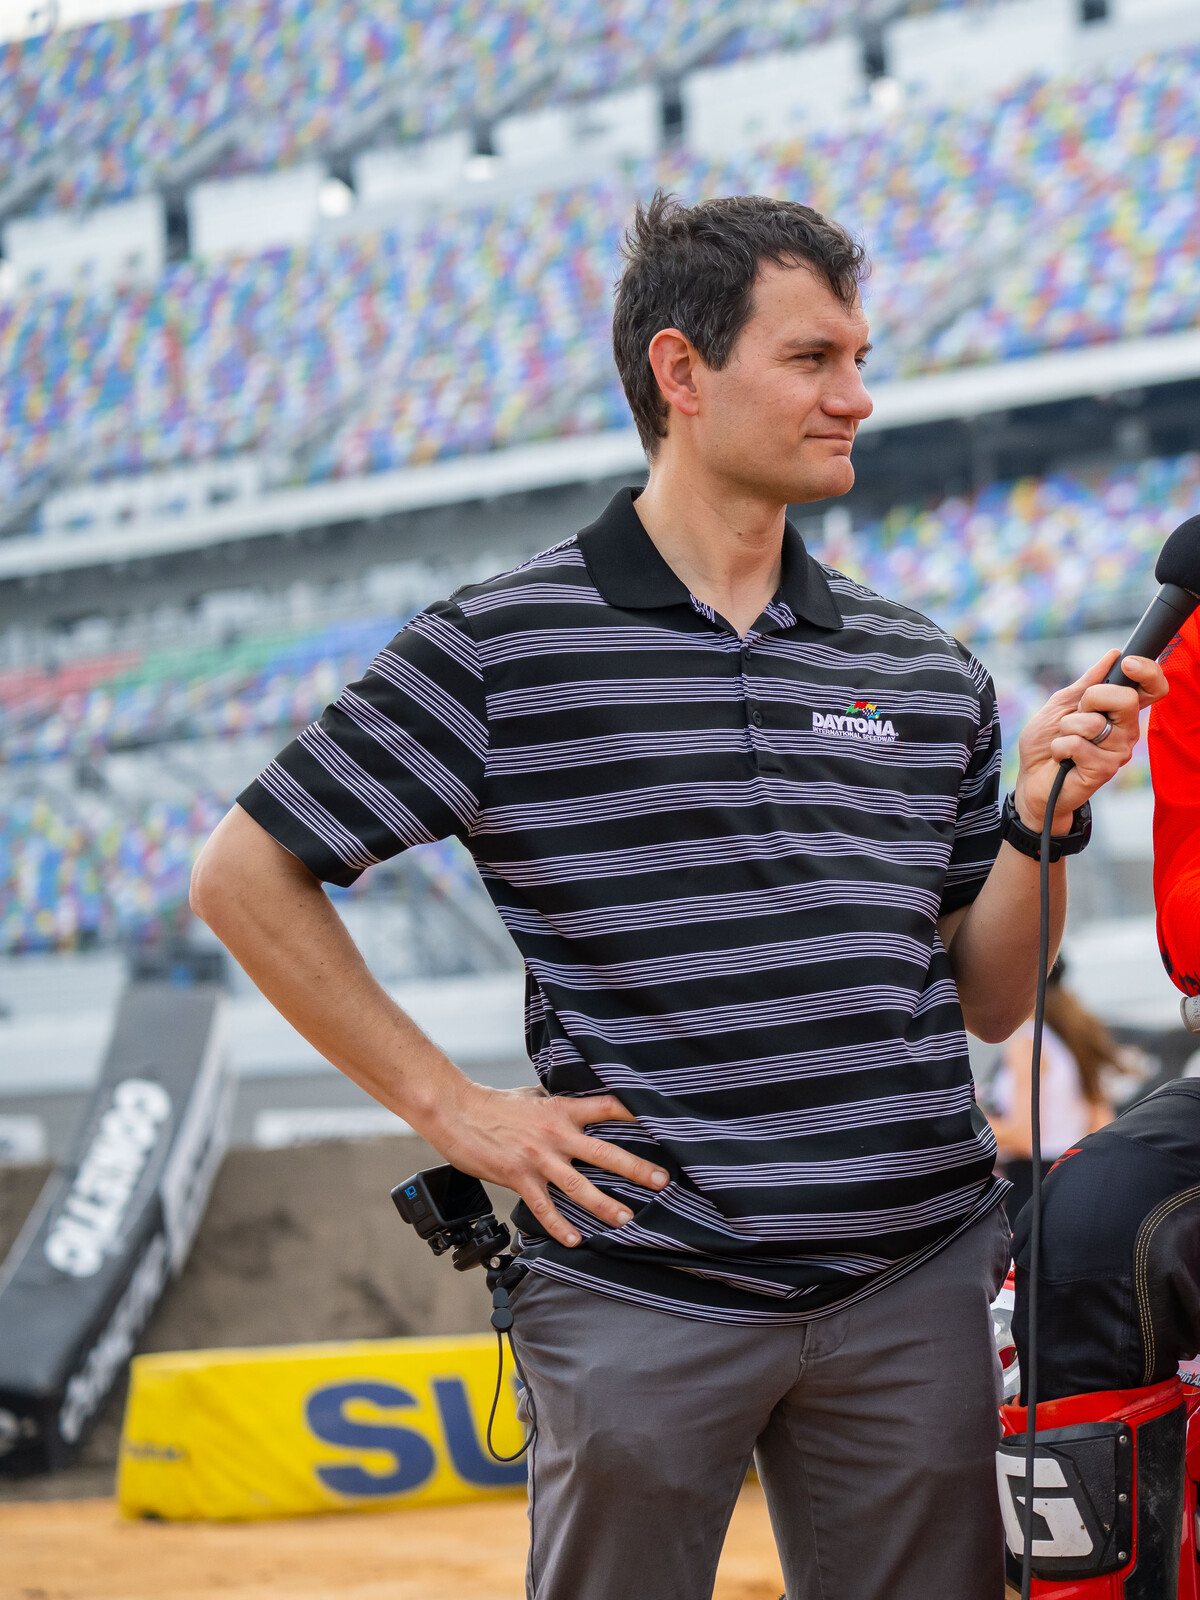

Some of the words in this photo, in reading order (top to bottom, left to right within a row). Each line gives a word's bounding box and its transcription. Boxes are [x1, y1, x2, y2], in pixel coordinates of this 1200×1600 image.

[812, 712, 896, 737] DAYTONA
[813, 726, 862, 740] INTERNATIONAL
[862, 733, 896, 742] SPEEDWAY
